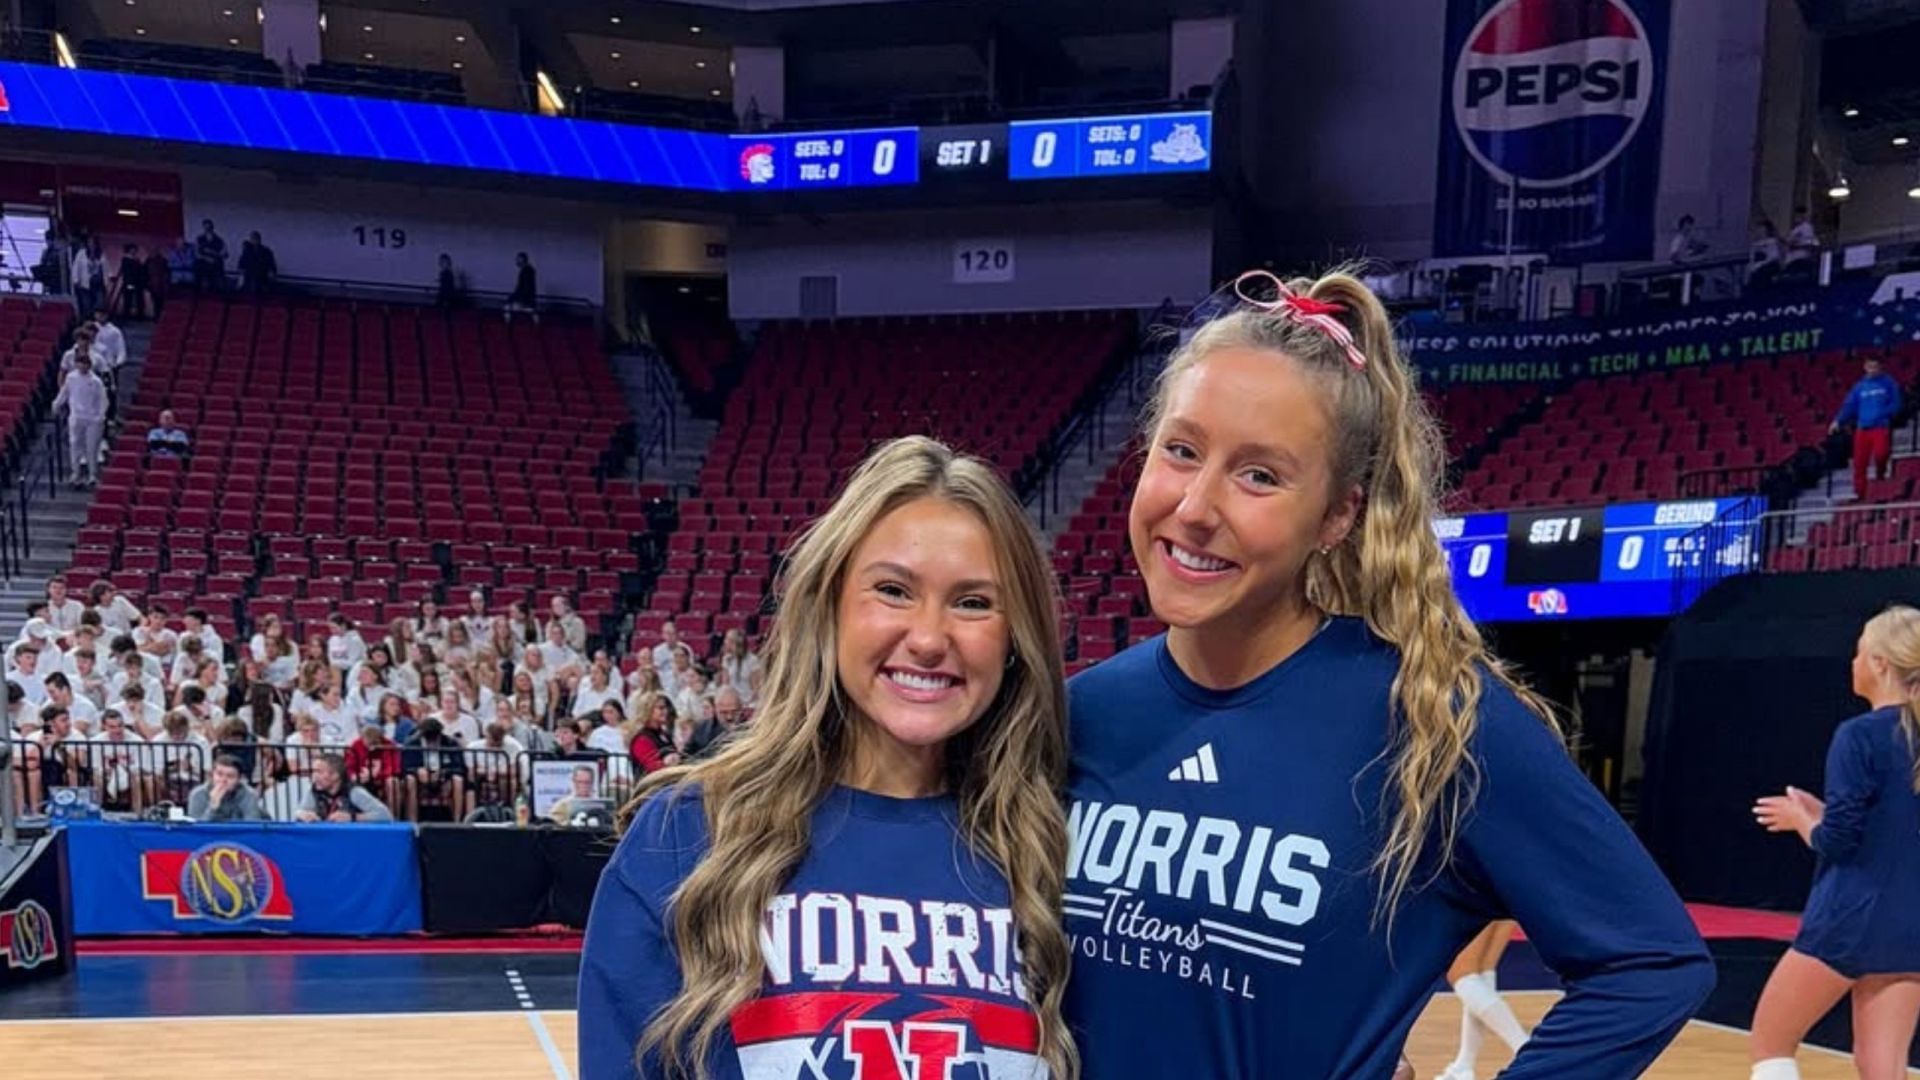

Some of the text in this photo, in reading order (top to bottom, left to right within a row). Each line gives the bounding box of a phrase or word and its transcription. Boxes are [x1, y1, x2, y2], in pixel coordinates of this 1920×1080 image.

[1465, 59, 1640, 109] PEPSI
[832, 139, 844, 156] 0
[1032, 131, 1057, 168] 0
[1129, 124, 1142, 141] 0
[873, 139, 896, 175] 0
[937, 139, 991, 166] SET 1
[1123, 148, 1136, 165] 0
[828, 163, 840, 179] 0
[352, 225, 406, 249] 119
[960, 250, 1009, 272] 120
[1449, 360, 1565, 383] FINANCIAL
[1589, 351, 1640, 375] TECH
[1665, 342, 1711, 367] M&A
[1740, 327, 1825, 357] TALENT
[1528, 517, 1582, 543] SET 1
[1468, 544, 1491, 578] 0
[1618, 535, 1644, 570] 0
[1065, 800, 1332, 926] NORRIS
[1103, 887, 1205, 951] Titans
[1064, 931, 1257, 1000] VOLLEYBALL
